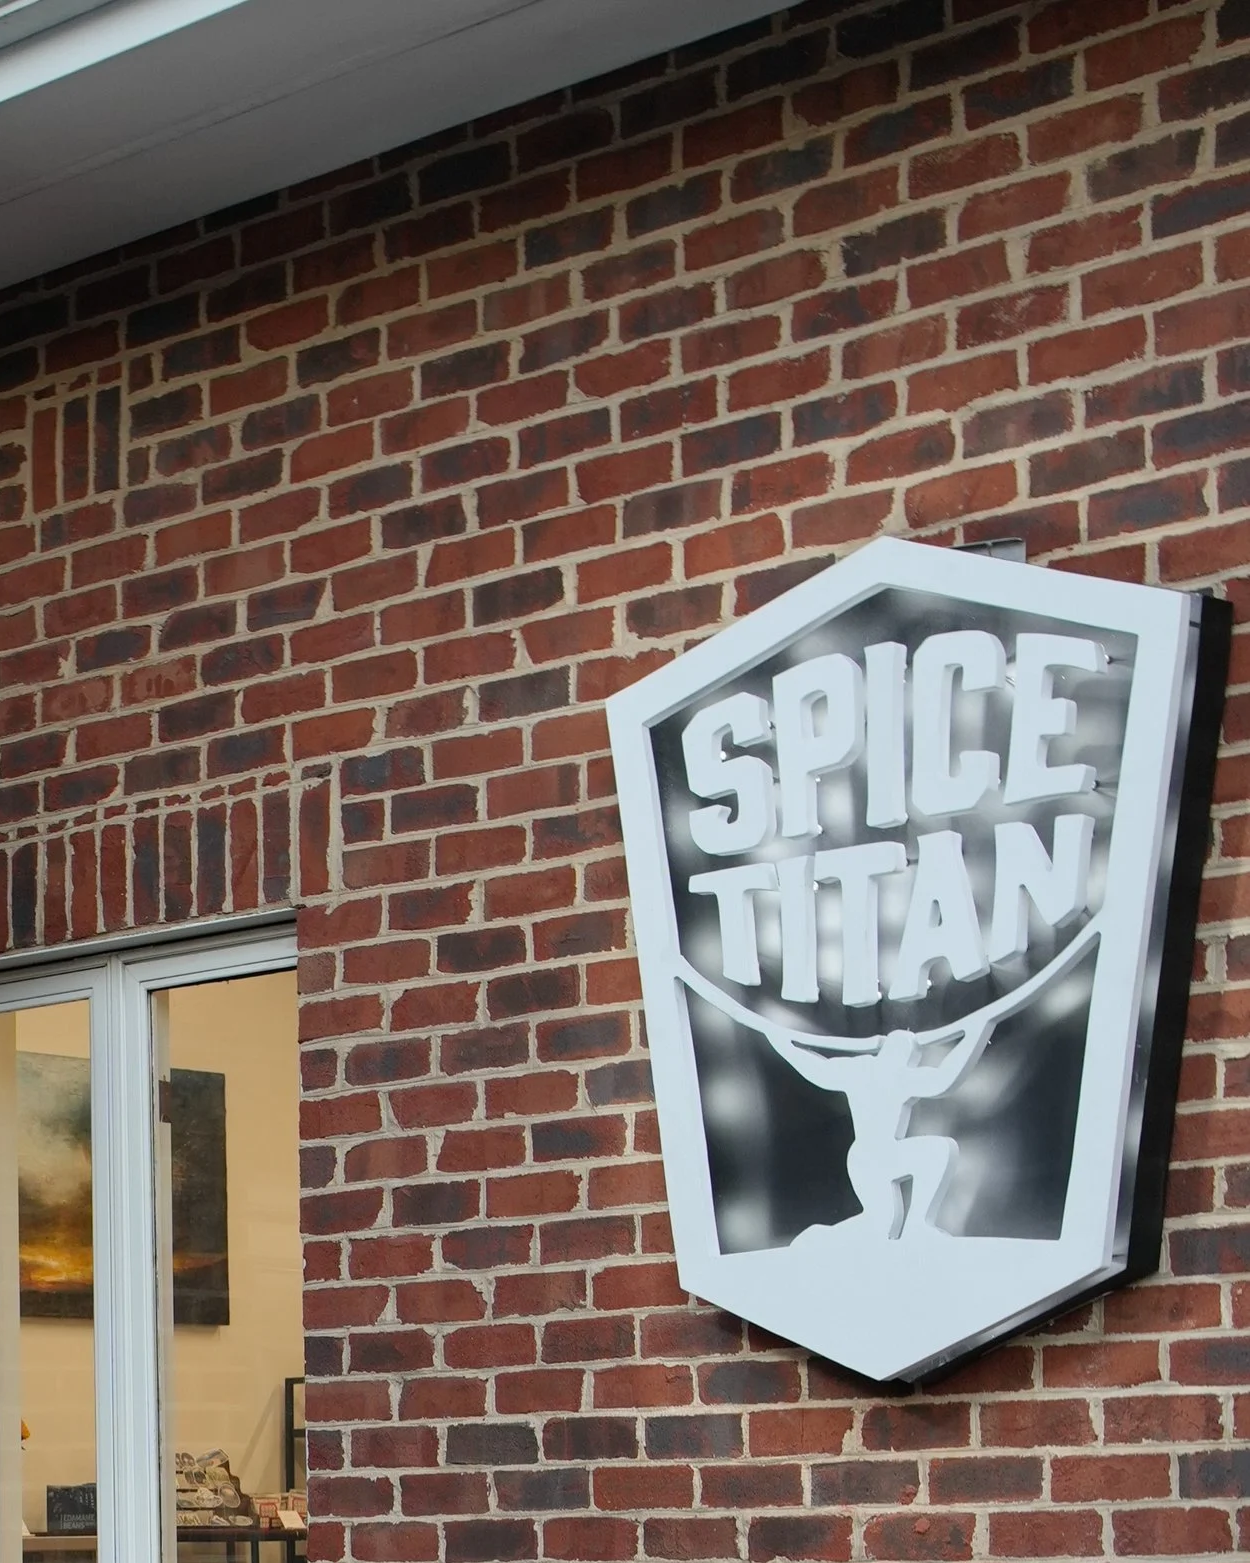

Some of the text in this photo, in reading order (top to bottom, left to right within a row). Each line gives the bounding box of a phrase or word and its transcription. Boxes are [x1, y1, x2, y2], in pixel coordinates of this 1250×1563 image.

[682, 630, 1108, 856] SPICE
[689, 814, 1095, 1007] TITAN
[63, 1521, 85, 1529] BEANS
